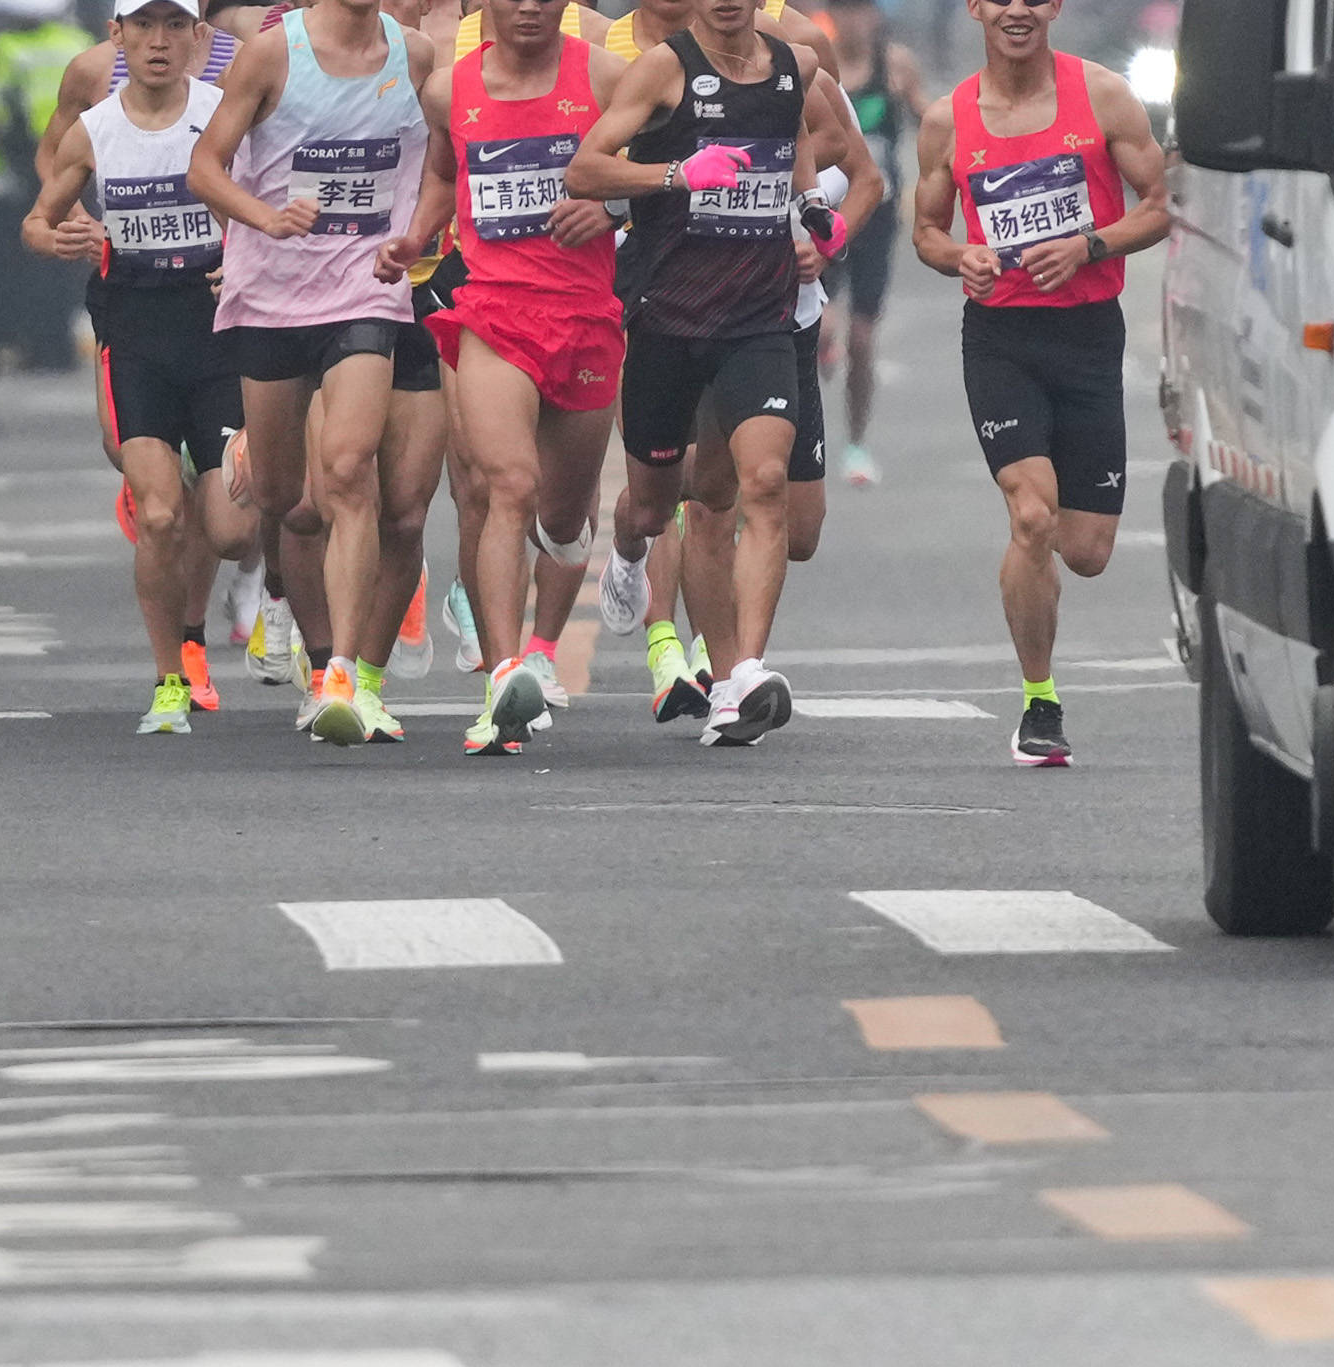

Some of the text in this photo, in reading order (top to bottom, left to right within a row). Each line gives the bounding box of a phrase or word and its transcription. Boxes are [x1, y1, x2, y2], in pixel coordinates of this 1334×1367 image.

[317, 178, 376, 208] 李岩
[118, 210, 212, 243] 孙晓阳
[714, 226, 774, 236] VOLVO
[989, 191, 1083, 242] 杨绍辉
